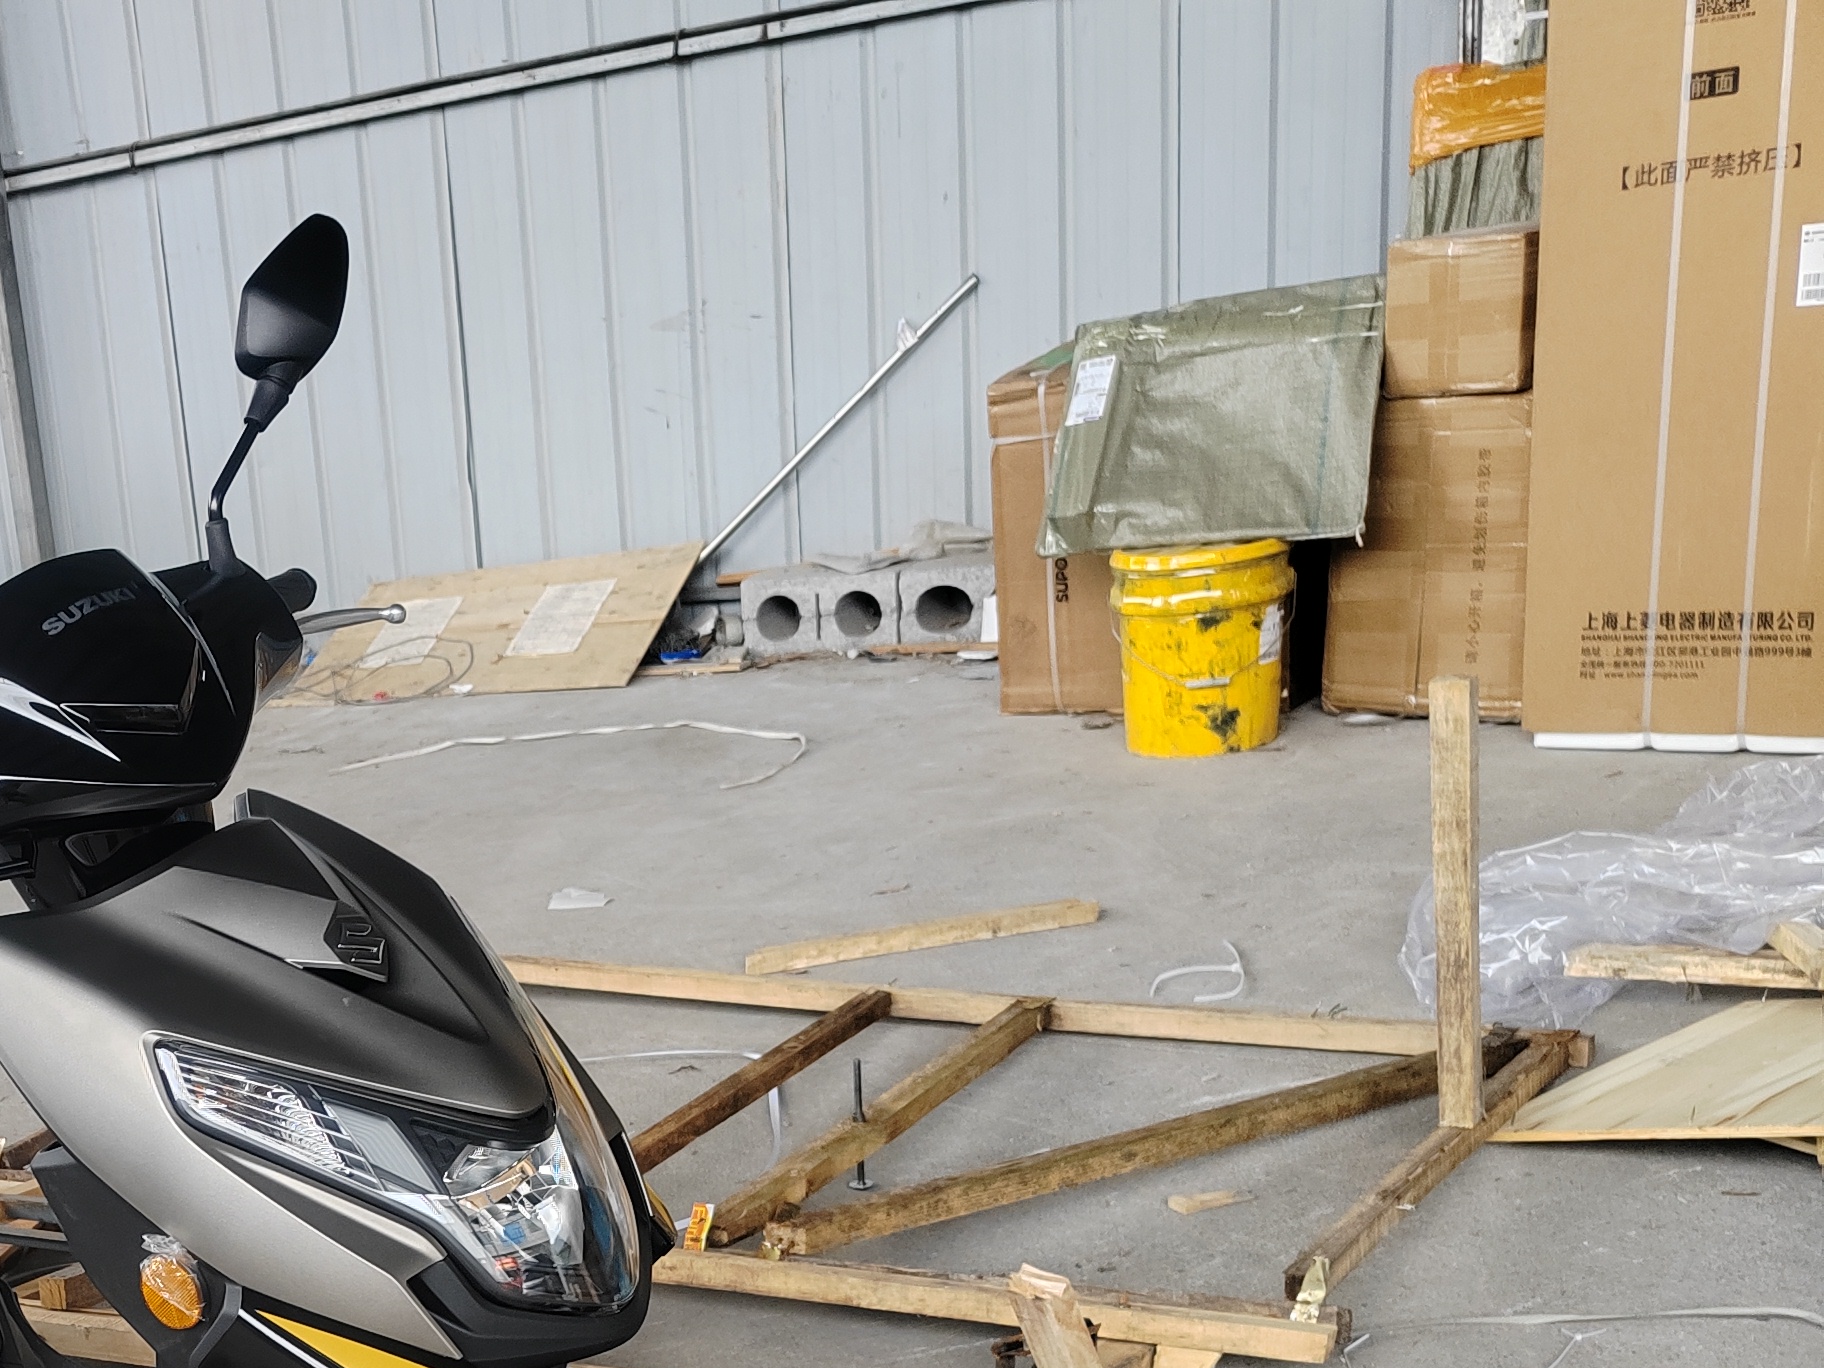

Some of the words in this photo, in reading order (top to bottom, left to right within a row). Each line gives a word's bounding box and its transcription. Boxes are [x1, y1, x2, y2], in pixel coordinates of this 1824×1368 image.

[1690, 71, 1736, 99] 前面
[41, 582, 138, 636] SUZUKI
[1710, 634, 1779, 642] MANUFATURING
